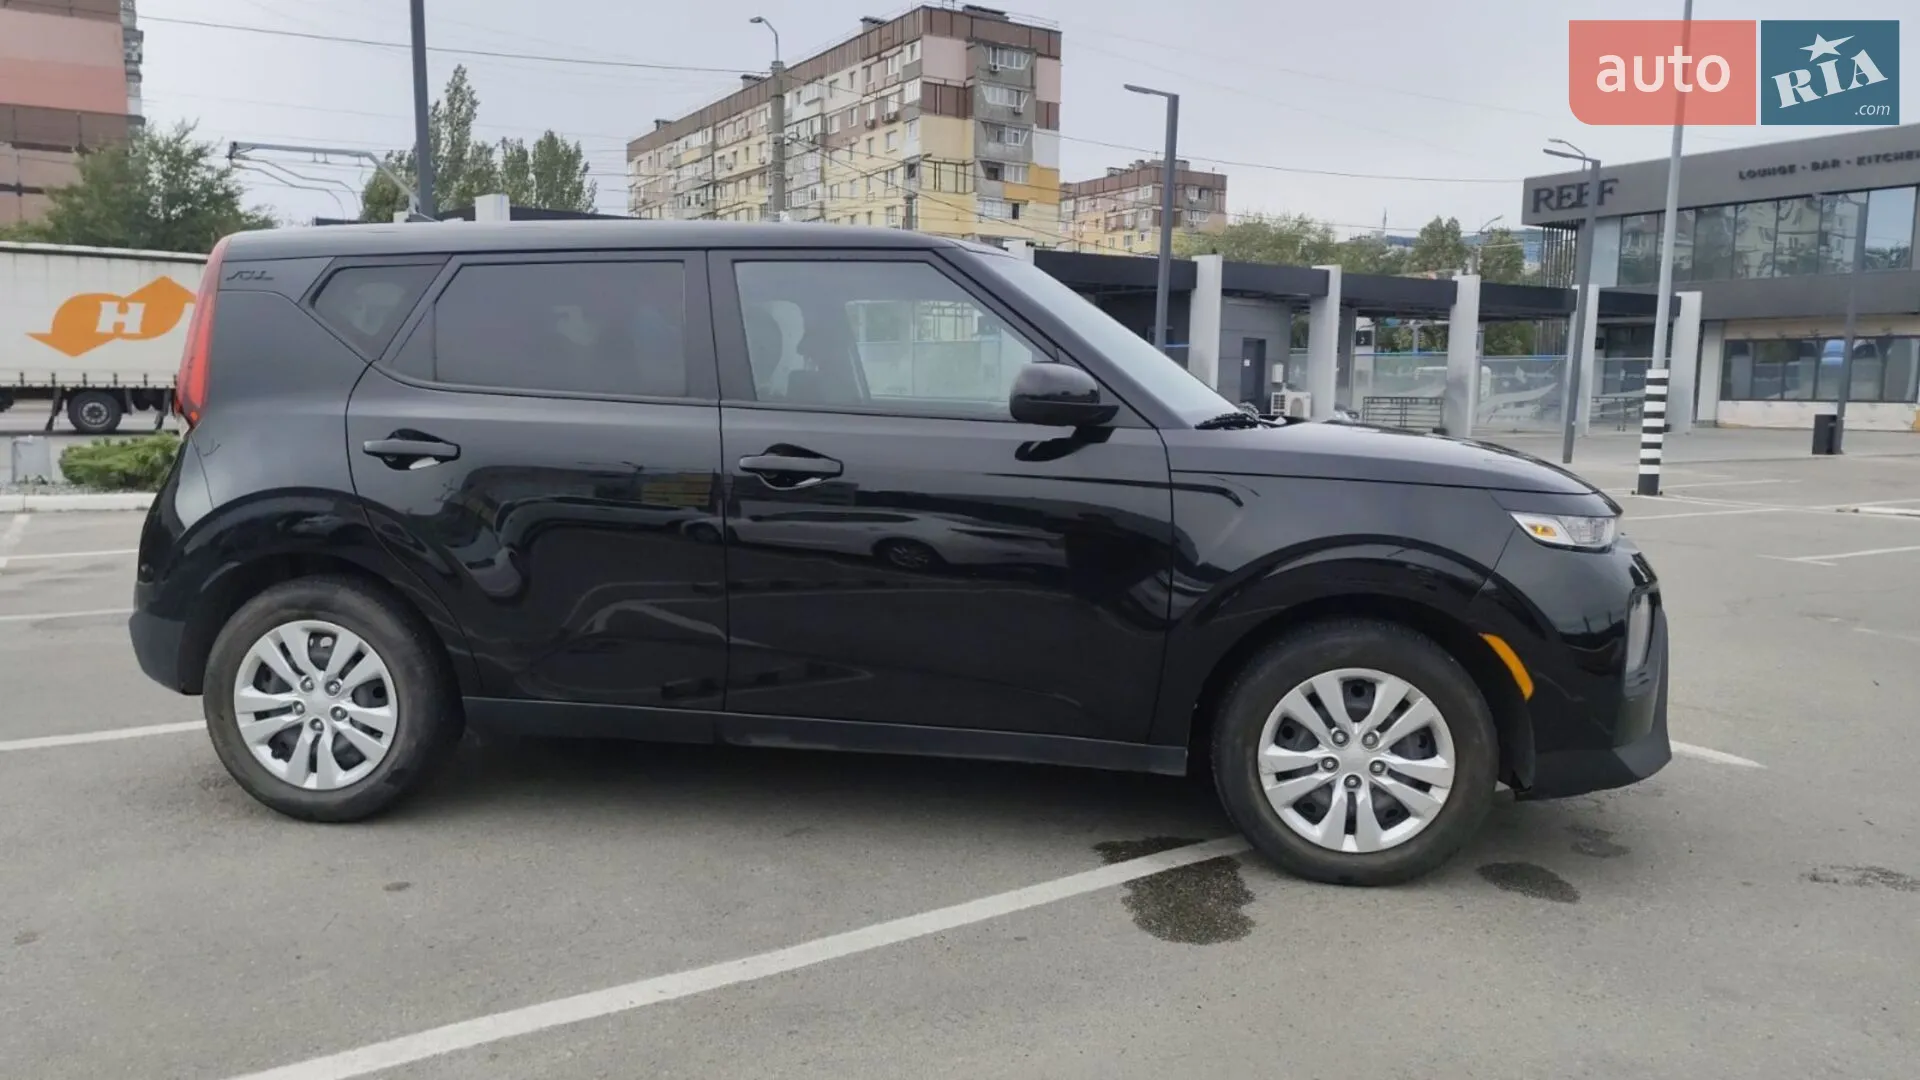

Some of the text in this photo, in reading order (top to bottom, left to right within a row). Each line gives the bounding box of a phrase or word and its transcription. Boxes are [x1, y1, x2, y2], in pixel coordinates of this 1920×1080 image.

[1738, 164, 1797, 180] LOUNGE
[1811, 158, 1841, 172] BAR
[1532, 178, 1619, 213] REEF
